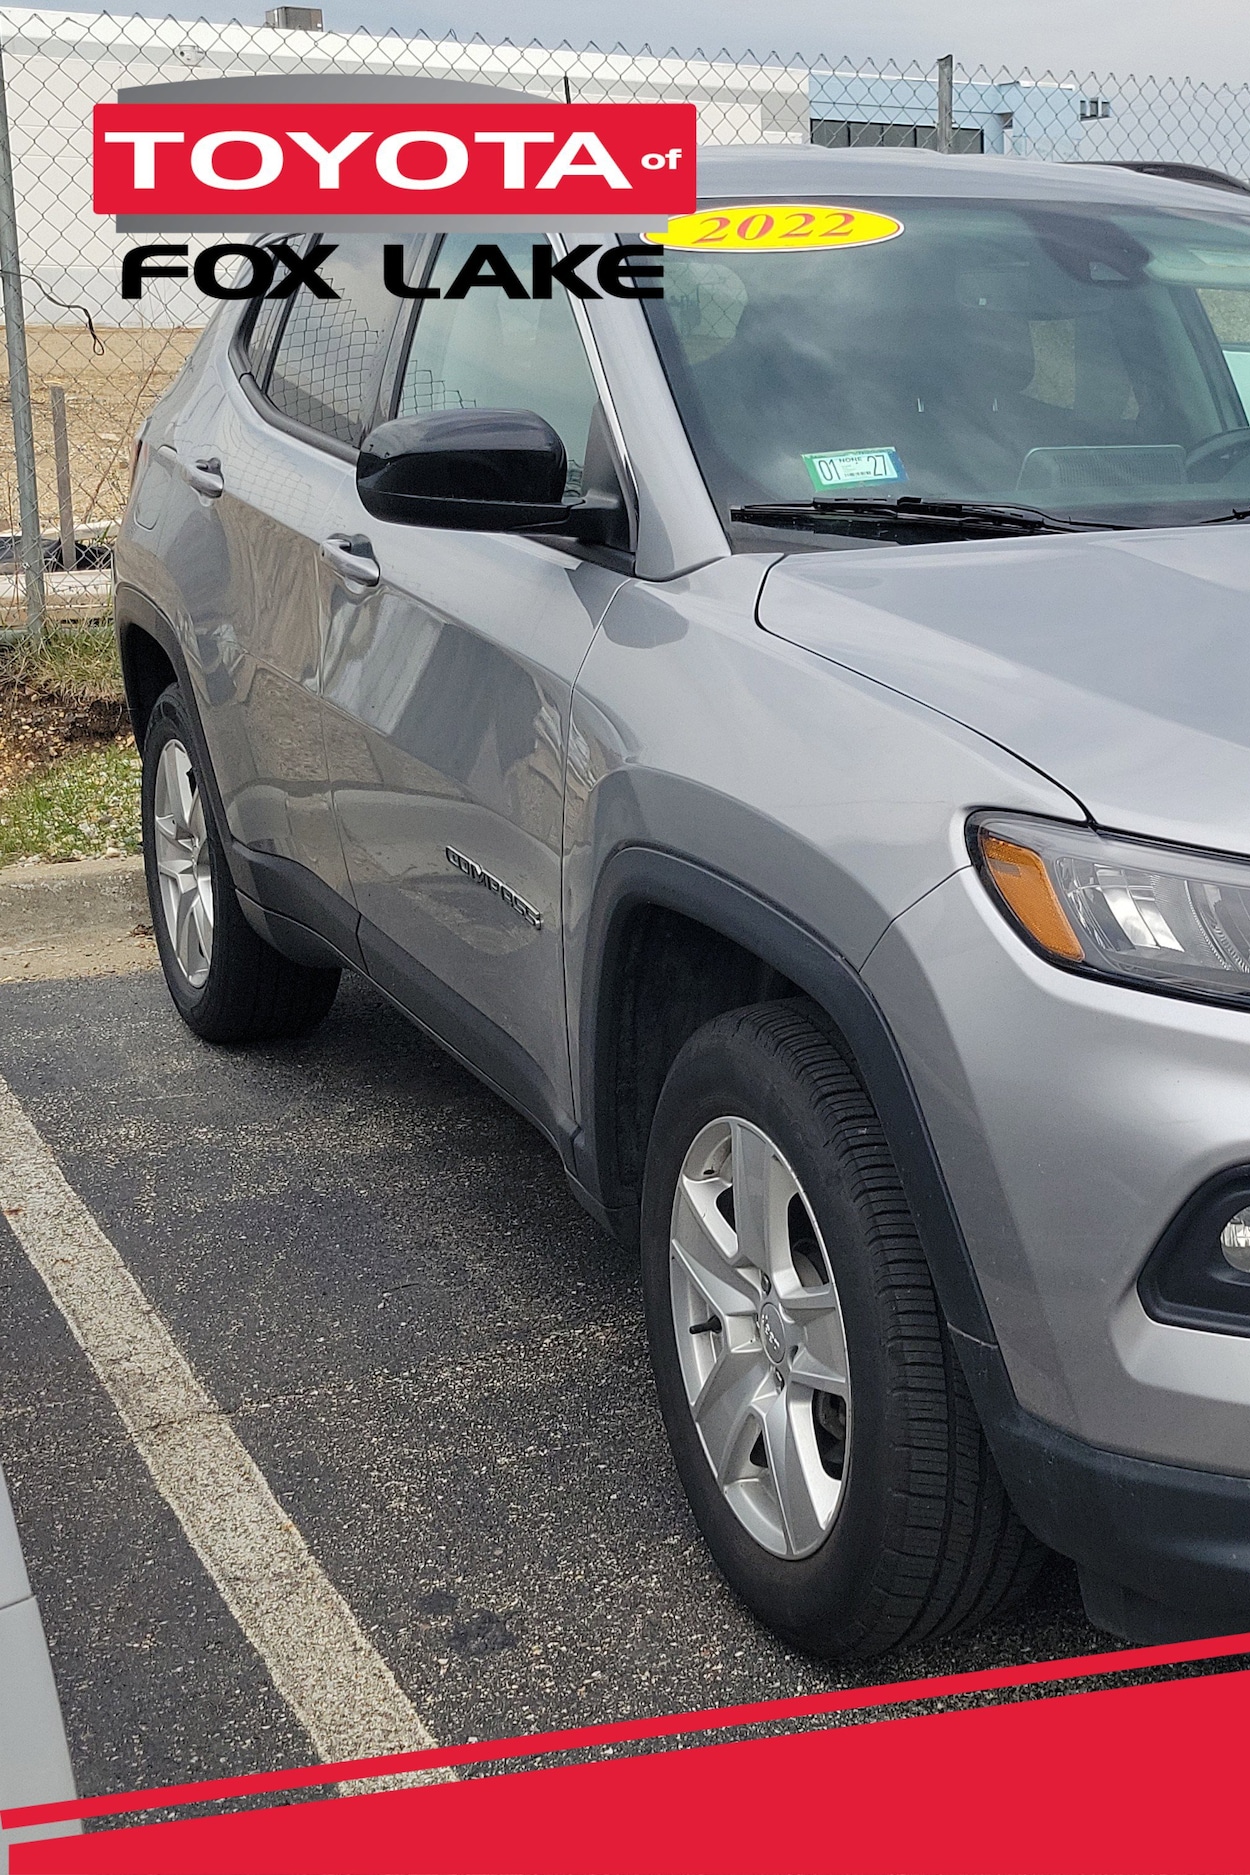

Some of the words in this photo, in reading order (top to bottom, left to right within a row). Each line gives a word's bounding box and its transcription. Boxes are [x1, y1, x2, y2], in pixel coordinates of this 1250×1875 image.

[691, 212, 856, 245] 2022
[818, 459, 841, 481] 01
[867, 454, 887, 477] 27
[445, 845, 543, 931] COMPASS
